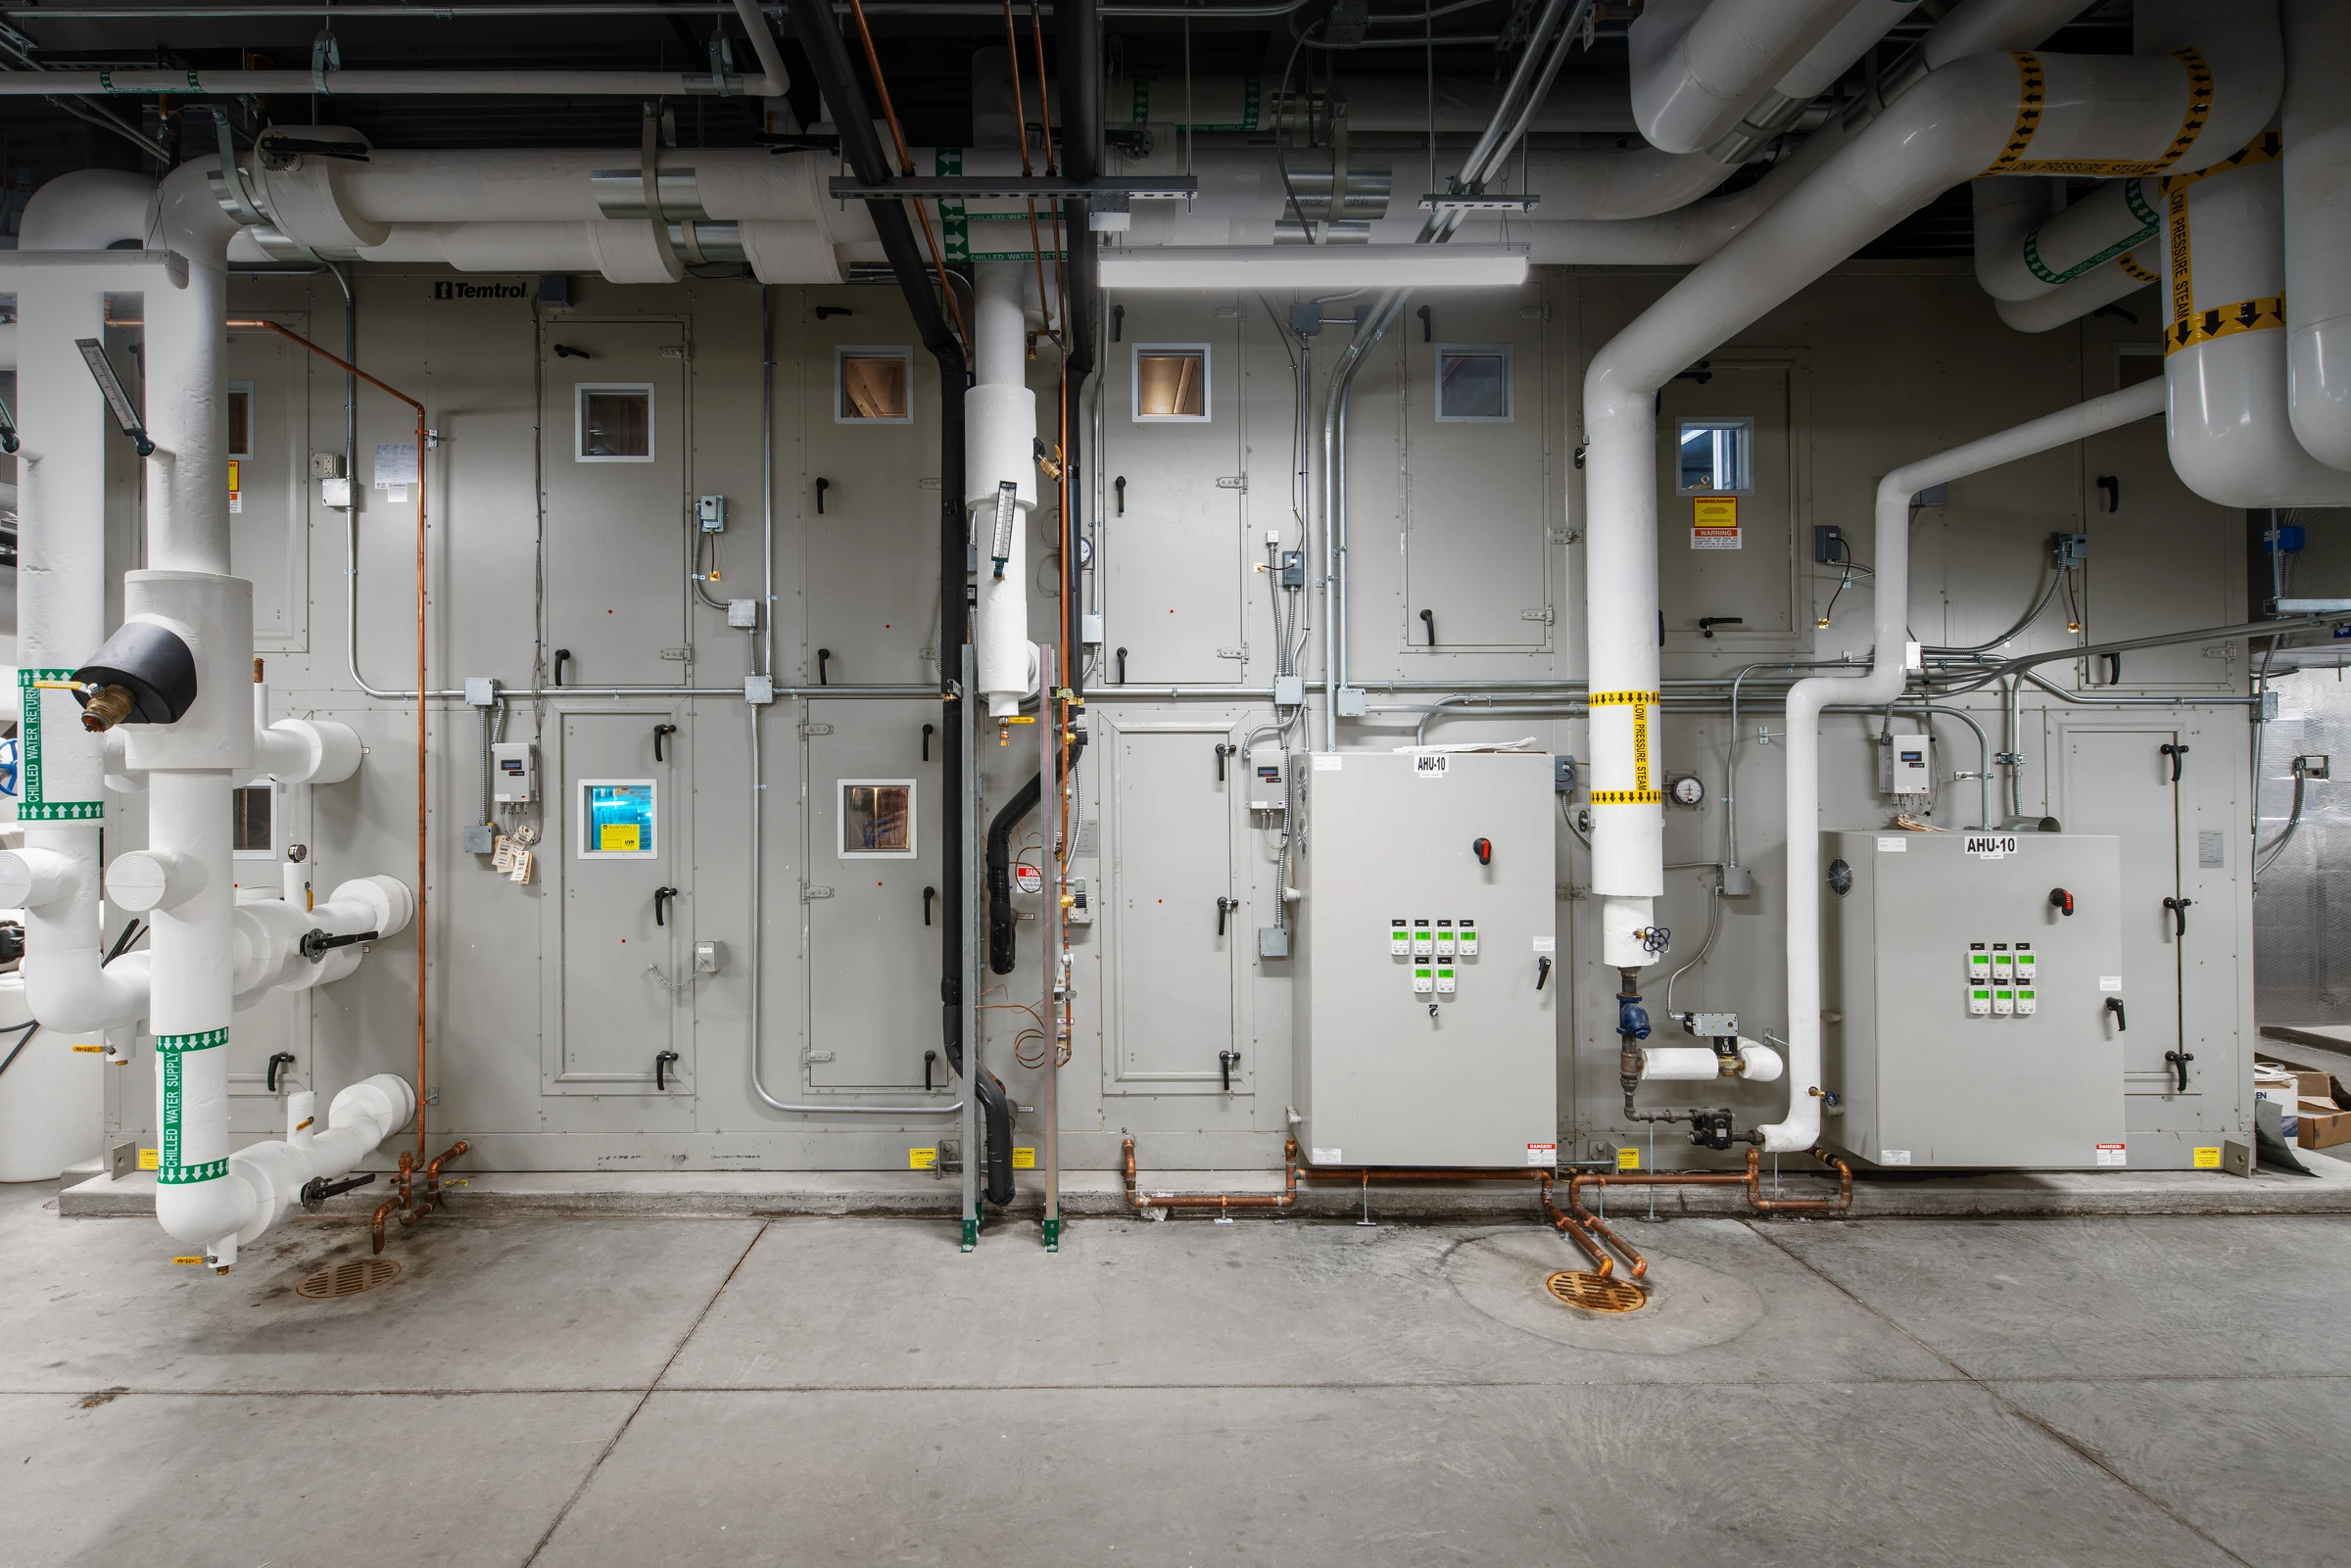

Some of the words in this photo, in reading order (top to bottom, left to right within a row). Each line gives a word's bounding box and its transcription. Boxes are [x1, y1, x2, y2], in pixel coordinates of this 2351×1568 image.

[2006, 162, 2039, 171] LOW
[2040, 162, 2108, 173] PRESSURE
[2106, 164, 2152, 174] STEAM
[2171, 186, 2184, 214] LOW
[2173, 216, 2187, 279] PRESSURE
[455, 282, 527, 298] Temtrol
[2175, 280, 2189, 319] STEAM
[25, 687, 37, 724] RETURN
[1635, 703, 1645, 721] LOW
[25, 728, 38, 760] WATER
[1636, 724, 1647, 763] PRESSURE
[1417, 756, 1446, 771] AHU-10
[1637, 767, 1647, 791] STEAM
[26, 764, 40, 803] CHILLED
[1967, 837, 2015, 852] AHU-10
[1026, 868, 1043, 877] DANGE
[167, 1052, 179, 1087] SUPPLY
[166, 1091, 178, 1124] WATER
[166, 1128, 178, 1168] CHILLED
